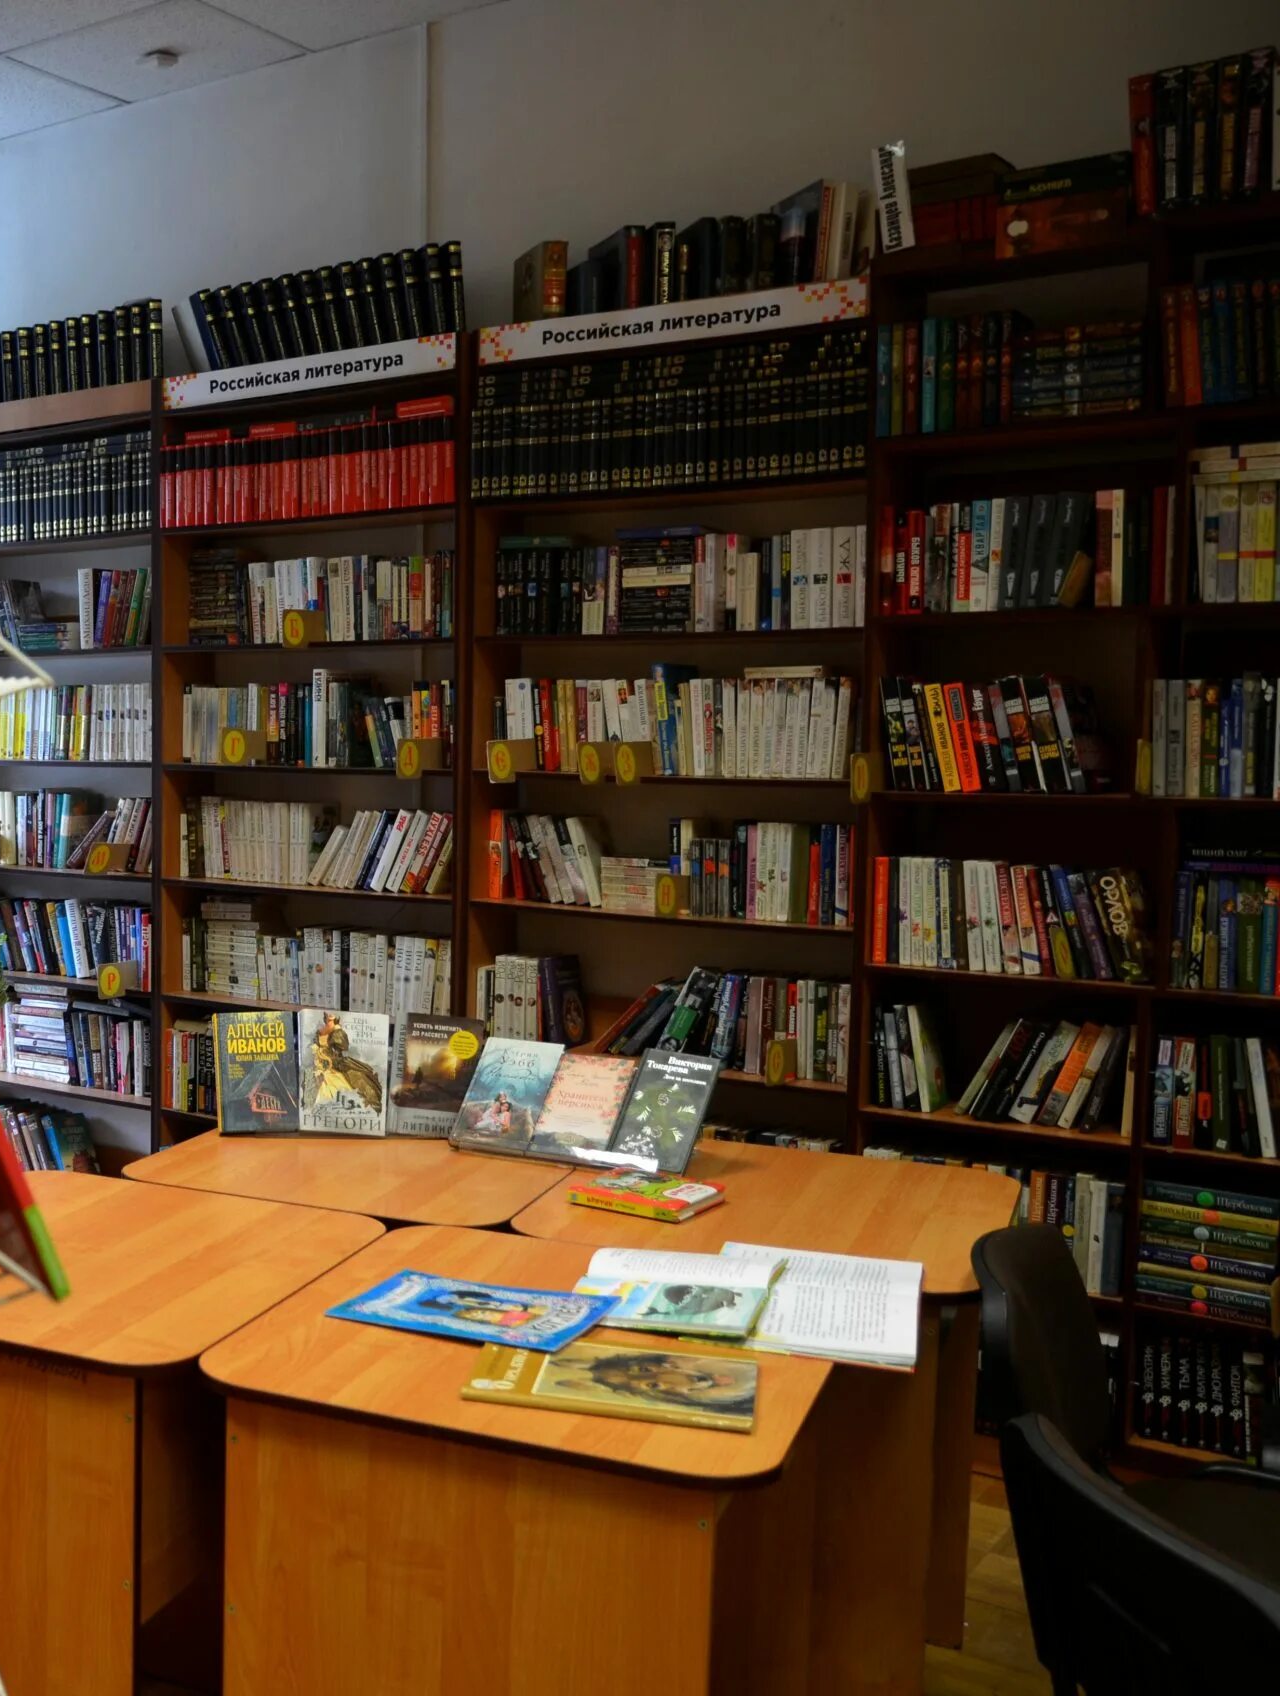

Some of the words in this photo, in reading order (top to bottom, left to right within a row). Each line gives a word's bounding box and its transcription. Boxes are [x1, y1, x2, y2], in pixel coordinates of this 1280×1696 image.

[541, 318, 654, 345] Российская
[658, 302, 782, 333] литература
[209, 366, 300, 394] Российская
[305, 352, 404, 381] литература
[938, 722, 951, 751] ИВАНОВ
[226, 1020, 286, 1039] АЛЕКСЕЙ
[413, 1022, 434, 1031] УСПЕТЬ
[420, 1031, 449, 1040] РАССВЕТА
[227, 1038, 287, 1054] ИВАНОВ
[646, 1059, 689, 1075] Токарева
[668, 1055, 714, 1072] Виктория
[302, 1114, 383, 1131] ГРЕГОРИ
[1215, 1196, 1274, 1214] Щербакова
[1212, 1230, 1270, 1249] Щербакова
[1209, 1259, 1267, 1279] Щербакова
[1209, 1288, 1267, 1309] Щербакова
[1178, 1357, 1191, 1391] ТЬМА
